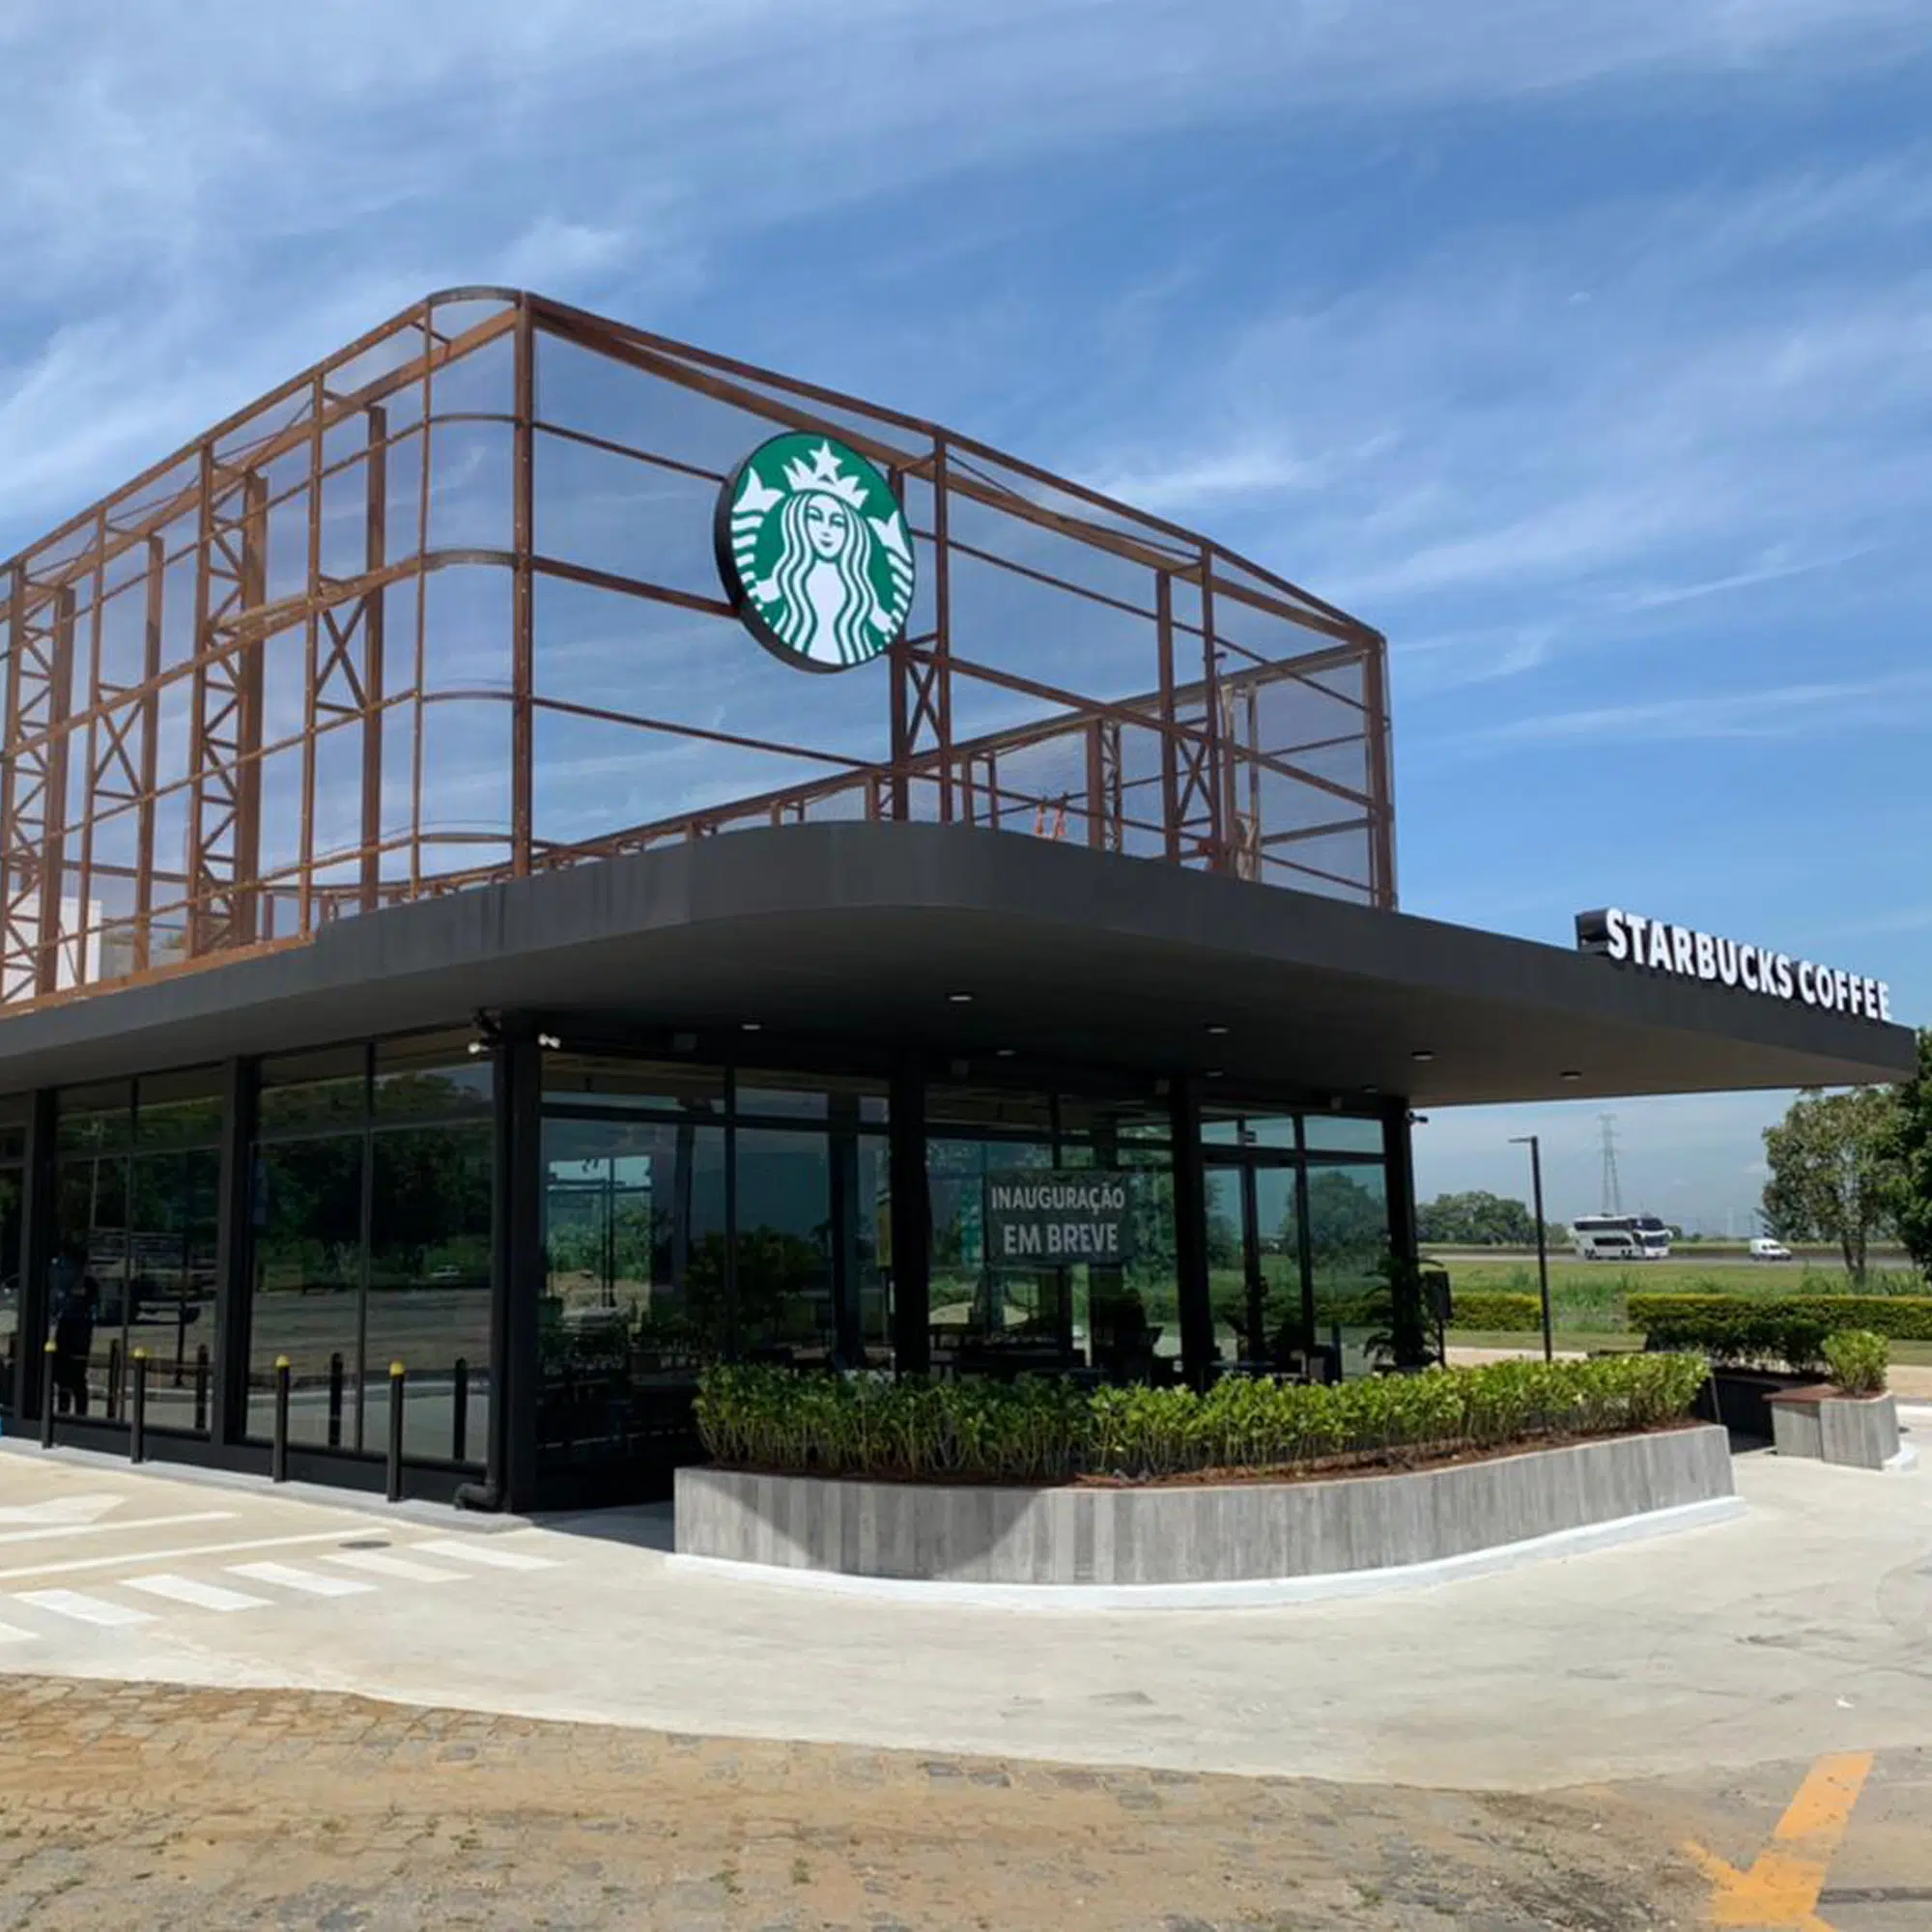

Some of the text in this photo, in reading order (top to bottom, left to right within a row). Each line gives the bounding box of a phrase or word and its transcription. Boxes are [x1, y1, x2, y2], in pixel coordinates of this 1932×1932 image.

[1605, 907, 1891, 1021] STARBUCKS COFFEE
[991, 1182, 1125, 1215] INAUGURAÇÃO
[1004, 1223, 1119, 1254] EM BREVE
